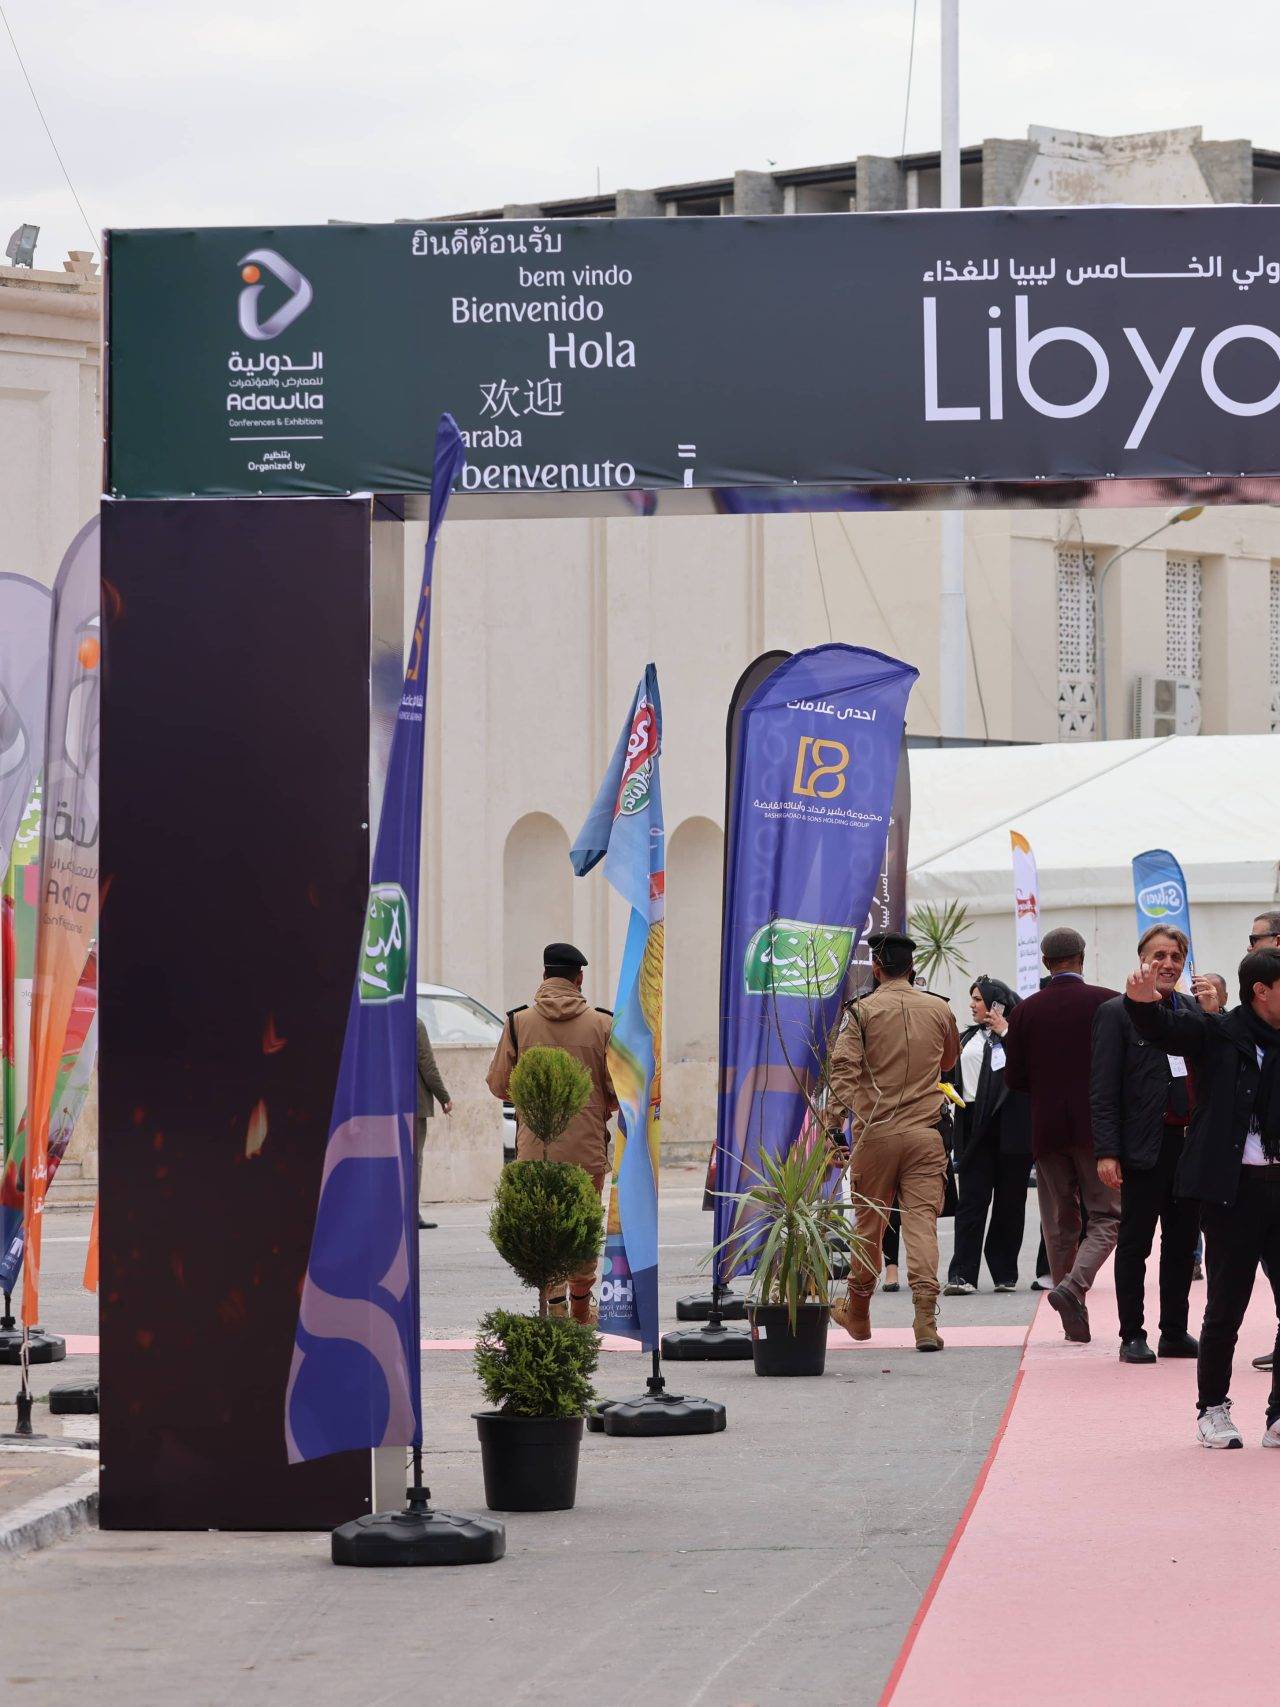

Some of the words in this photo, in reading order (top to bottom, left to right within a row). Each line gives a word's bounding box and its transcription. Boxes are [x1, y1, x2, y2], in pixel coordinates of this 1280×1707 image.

[411, 226, 563, 257] ยินดีต้อนรับ
[519, 266, 566, 287] bem
[572, 264, 633, 287] vindo
[922, 258, 999, 283] للغذاء
[1009, 257, 1056, 286] ليبيا
[1065, 255, 1223, 286] الخامس
[452, 294, 605, 325] Bienvenido
[548, 331, 636, 369] Hola
[227, 351, 324, 377] الدولية
[226, 392, 324, 411] Adawlia
[479, 377, 565, 418] 欢迎
[228, 418, 276, 427] Conferences
[284, 417, 324, 426] Exhibitions
[462, 425, 522, 448] araba
[247, 461, 292, 472] Organized
[294, 461, 306, 471] by
[462, 459, 636, 489] benvenuto
